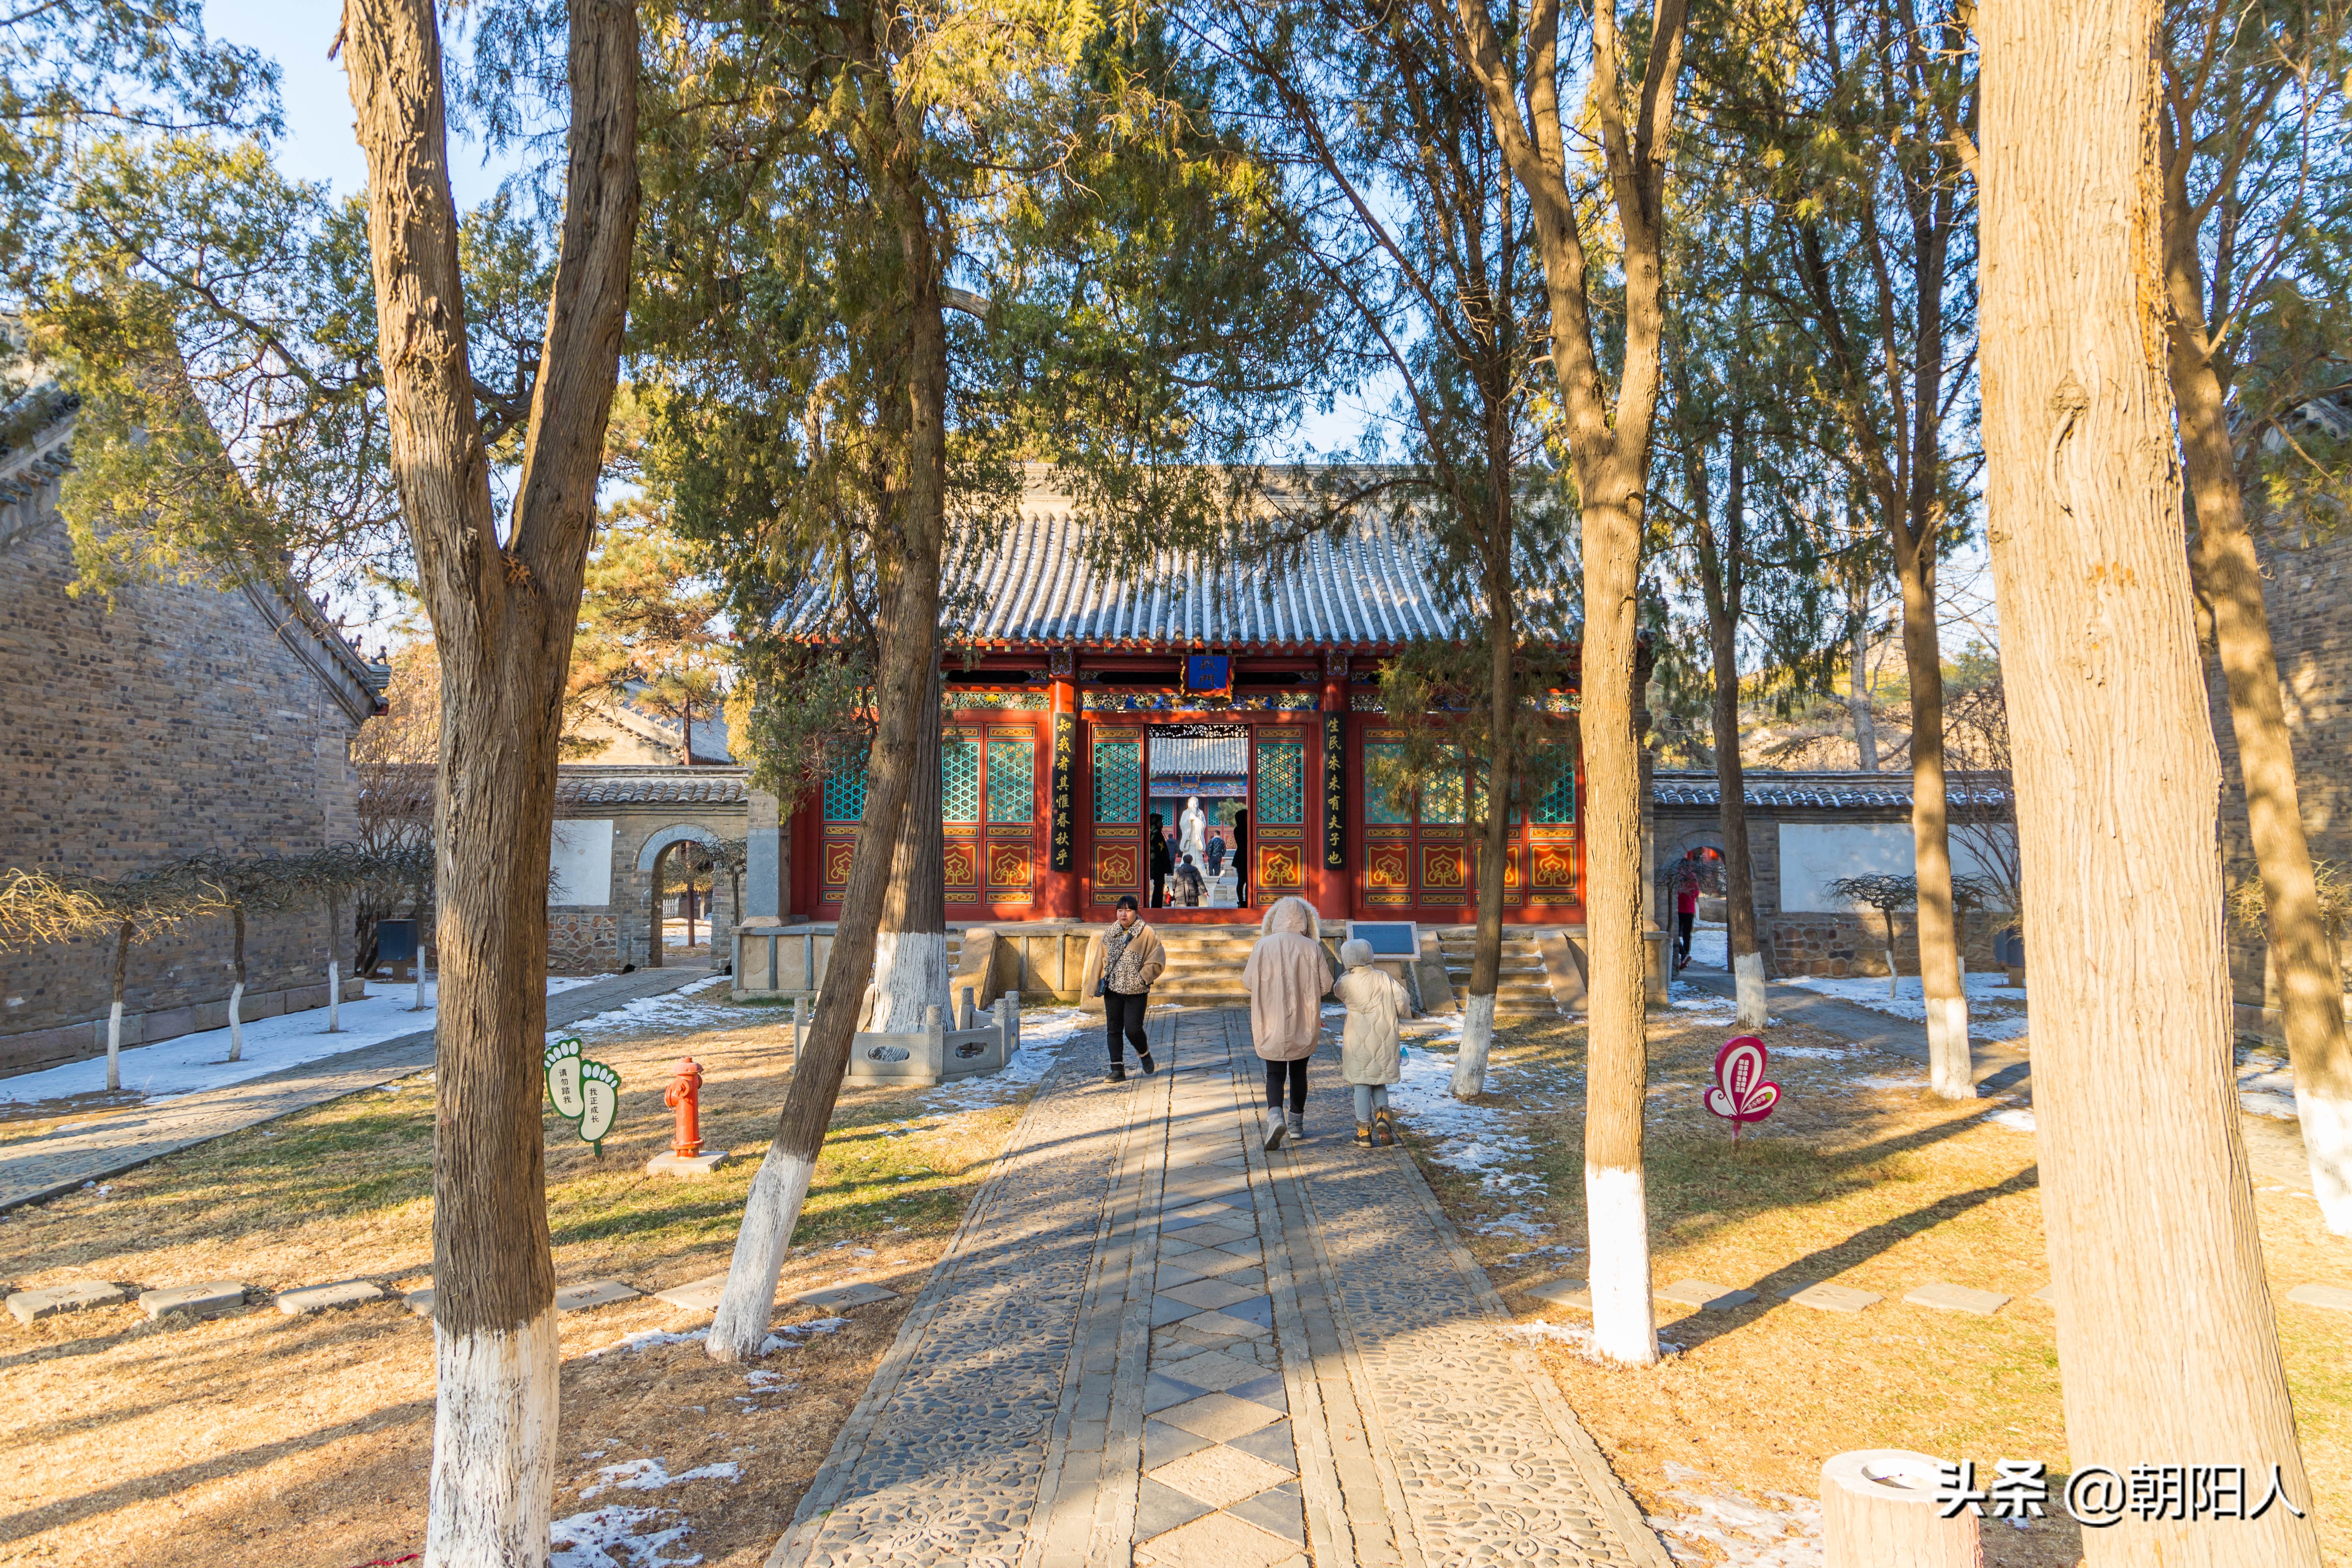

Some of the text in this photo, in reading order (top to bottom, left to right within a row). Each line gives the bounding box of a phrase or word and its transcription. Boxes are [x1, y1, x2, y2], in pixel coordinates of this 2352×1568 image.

[559, 1069, 572, 1104] 请勿踏我
[589, 1088, 599, 1123] 我正成长
